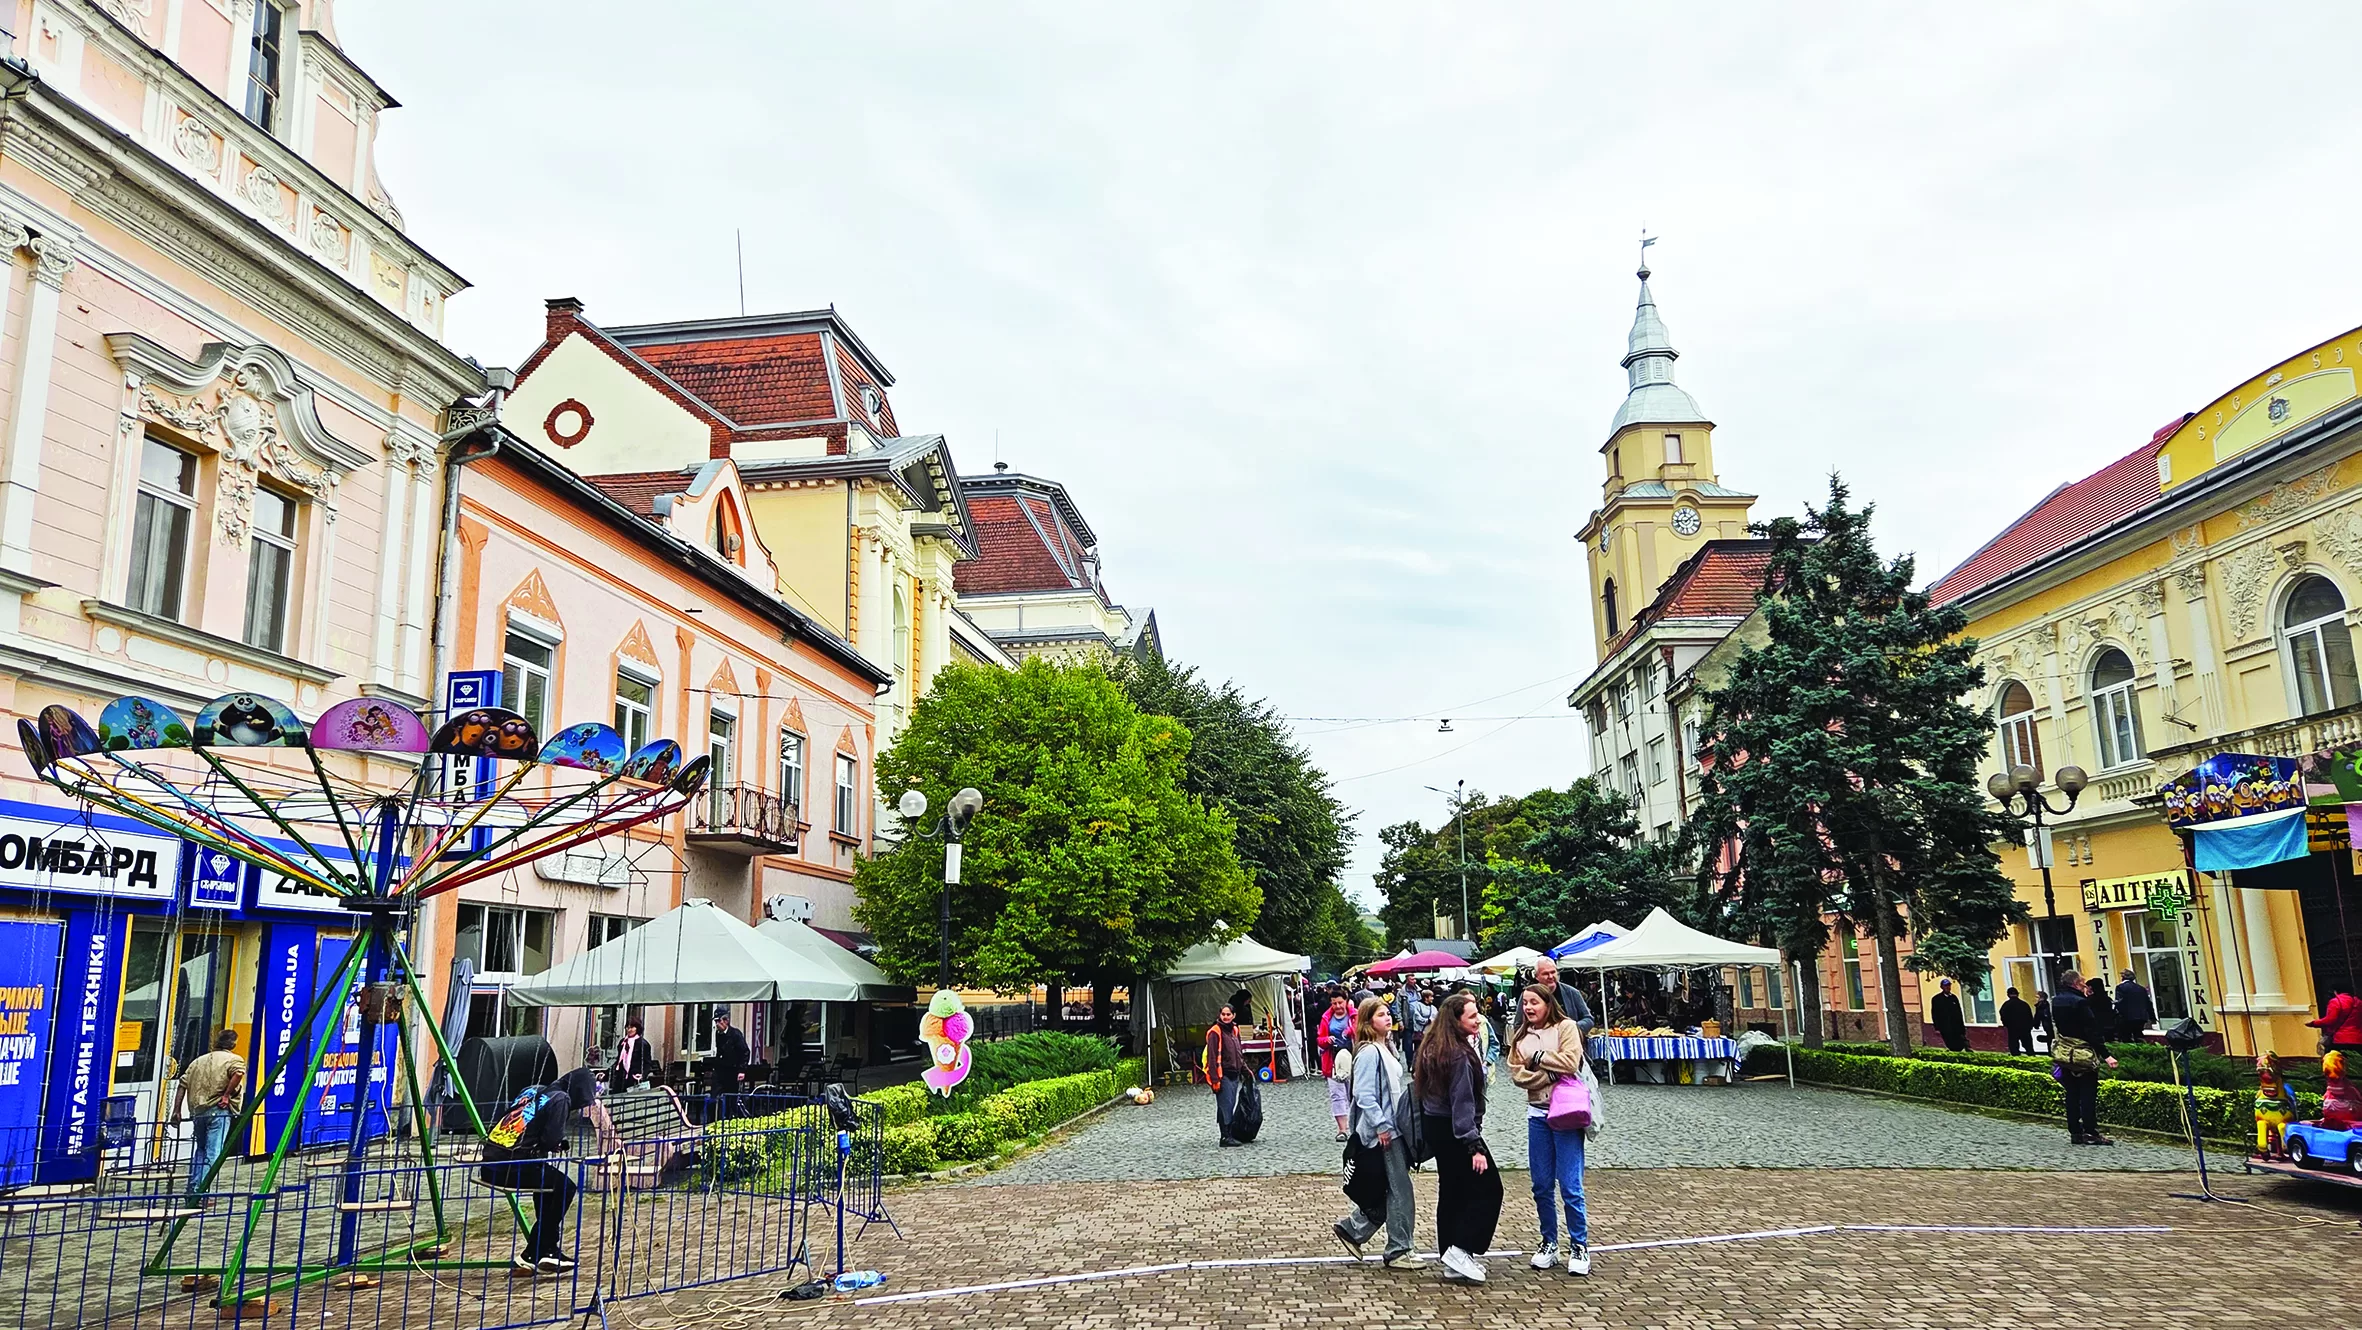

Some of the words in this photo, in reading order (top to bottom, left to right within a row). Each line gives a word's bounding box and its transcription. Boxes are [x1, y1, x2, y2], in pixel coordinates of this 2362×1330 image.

[81, 934, 106, 1036] ТЕХНІКИ
[274, 943, 300, 1097] SKRB.COM.UA
[0, 1033, 36, 1060] АЧУЙ
